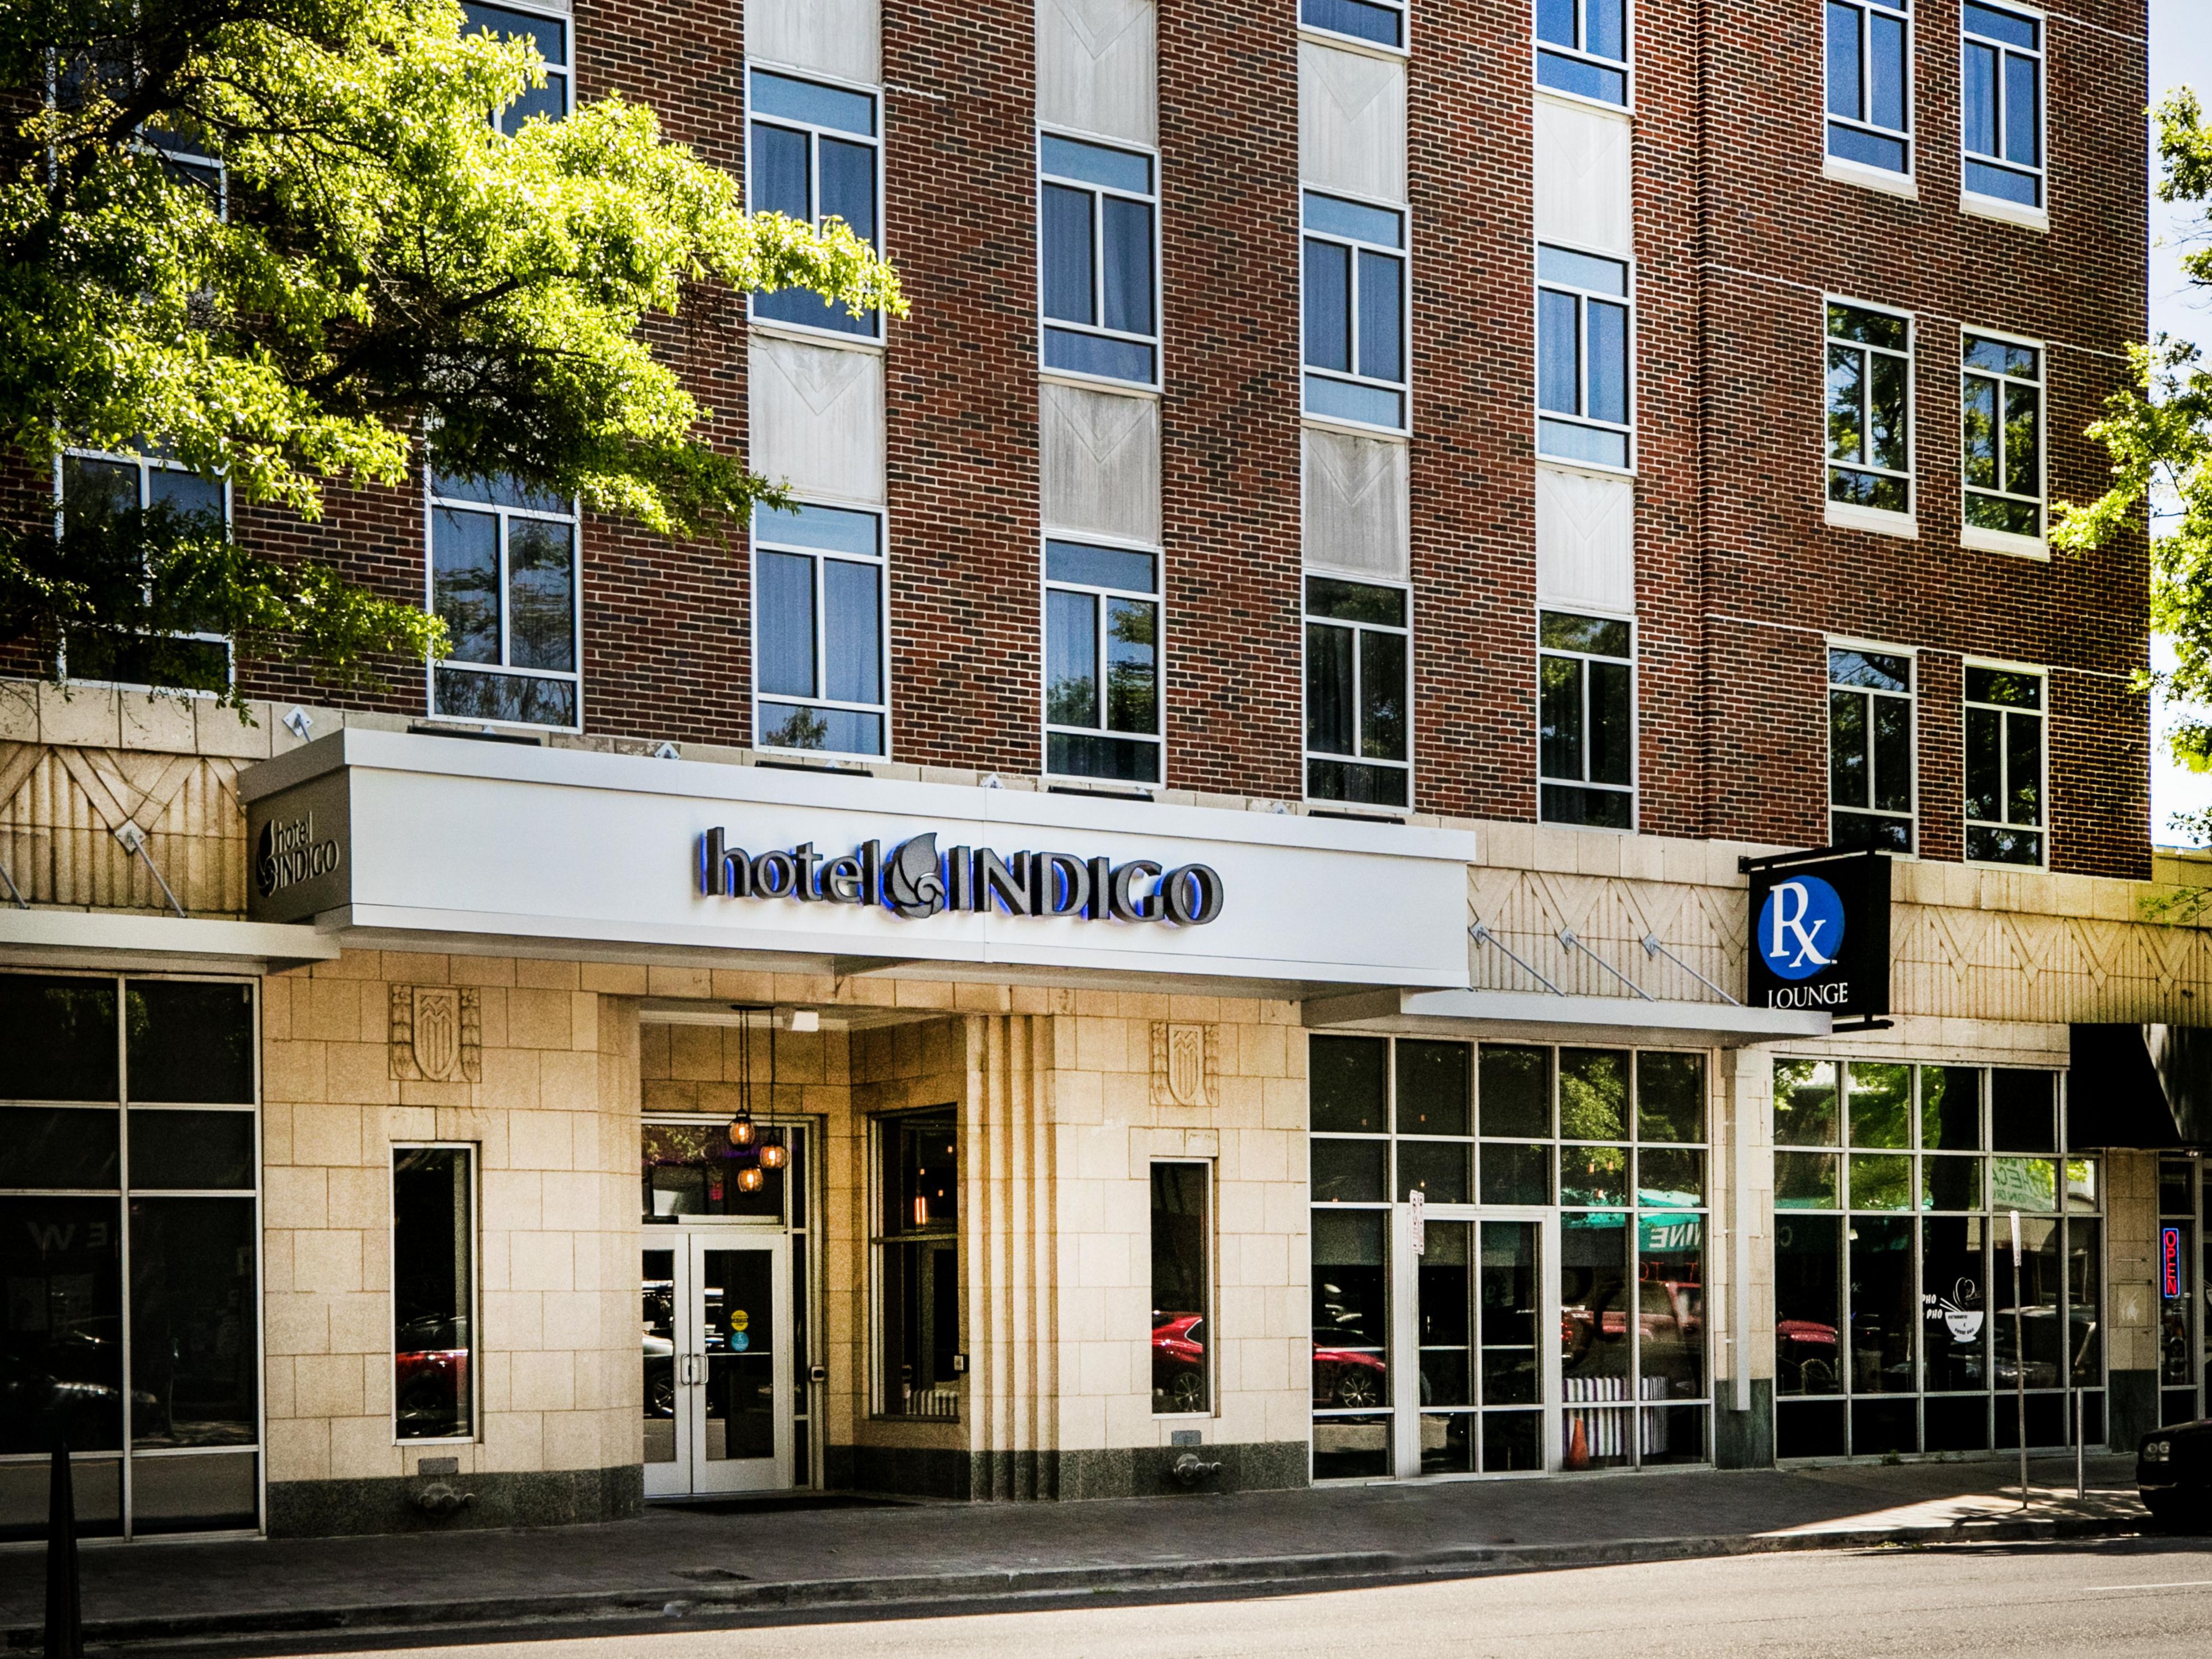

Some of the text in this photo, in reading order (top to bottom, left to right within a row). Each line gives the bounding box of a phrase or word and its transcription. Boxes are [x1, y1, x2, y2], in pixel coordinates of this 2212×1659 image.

[277, 811, 313, 853] hotel
[278, 839, 339, 889] INDIGO
[706, 826, 1224, 926] hotel INDIGO
[1768, 982, 1848, 1009] LOUNGE
[2164, 1231, 2177, 1295] OPEN
[1926, 1308, 1943, 1319] PHO
